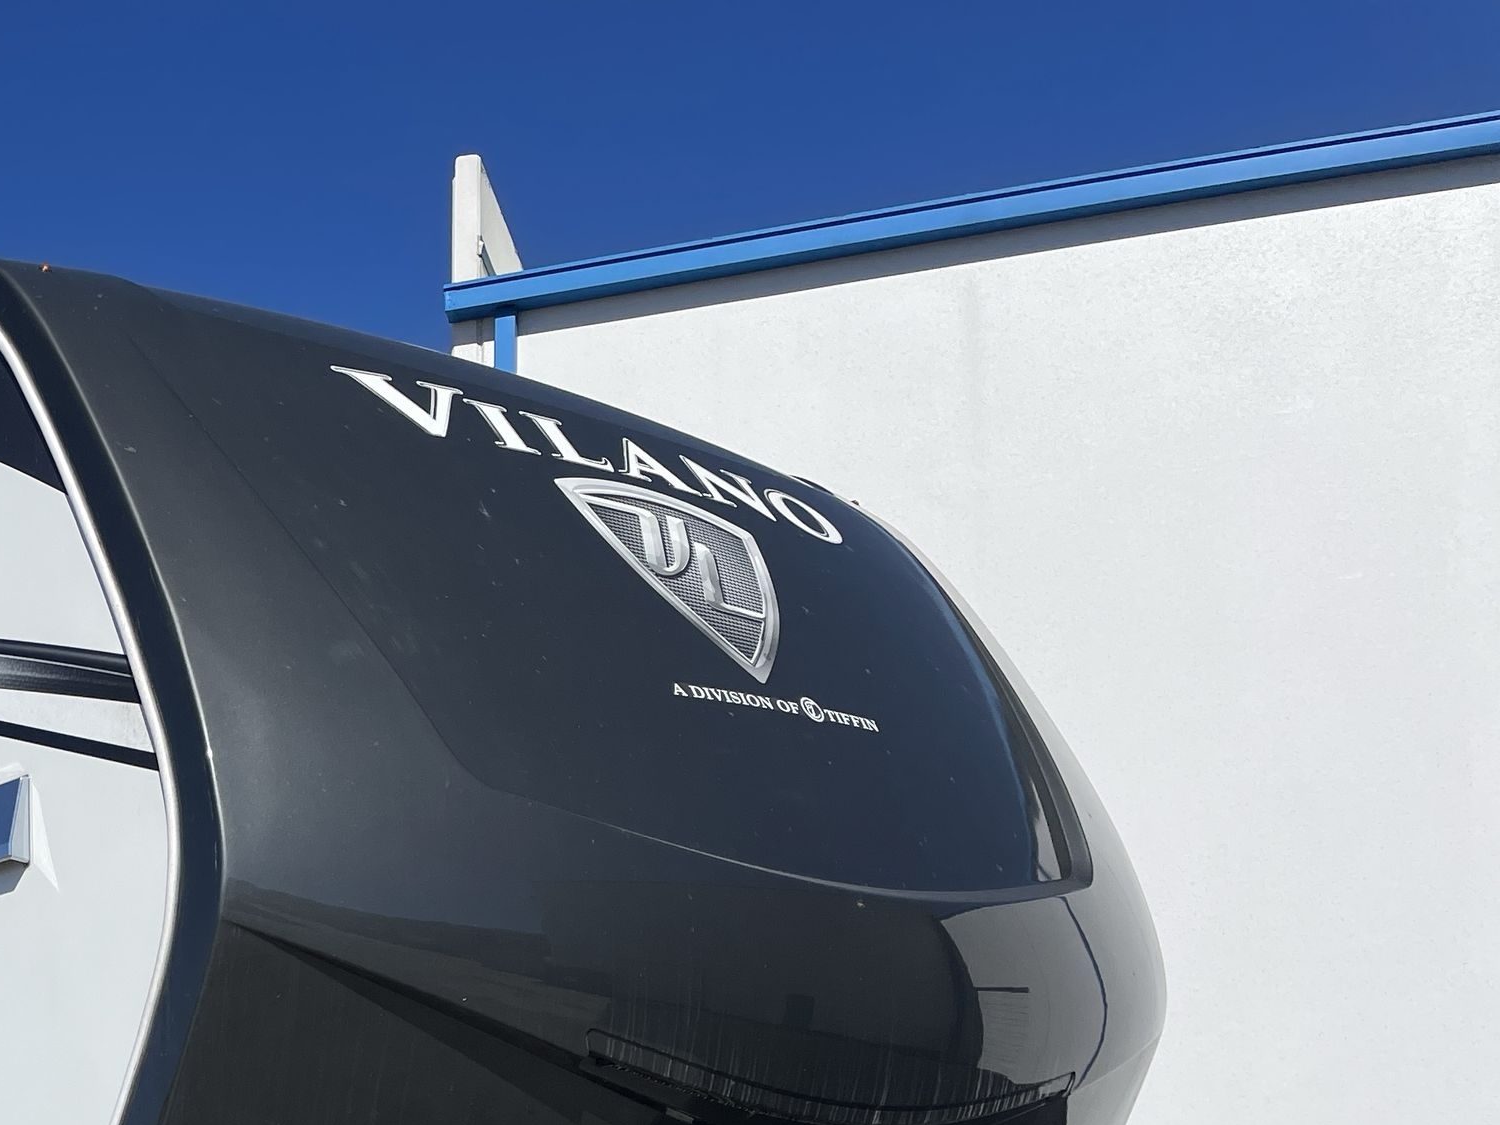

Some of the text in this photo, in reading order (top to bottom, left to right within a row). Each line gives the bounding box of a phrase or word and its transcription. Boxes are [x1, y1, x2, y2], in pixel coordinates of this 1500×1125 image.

[330, 364, 843, 545] VILANO
[673, 682, 880, 733] A DIVISION OF TIFFIN
